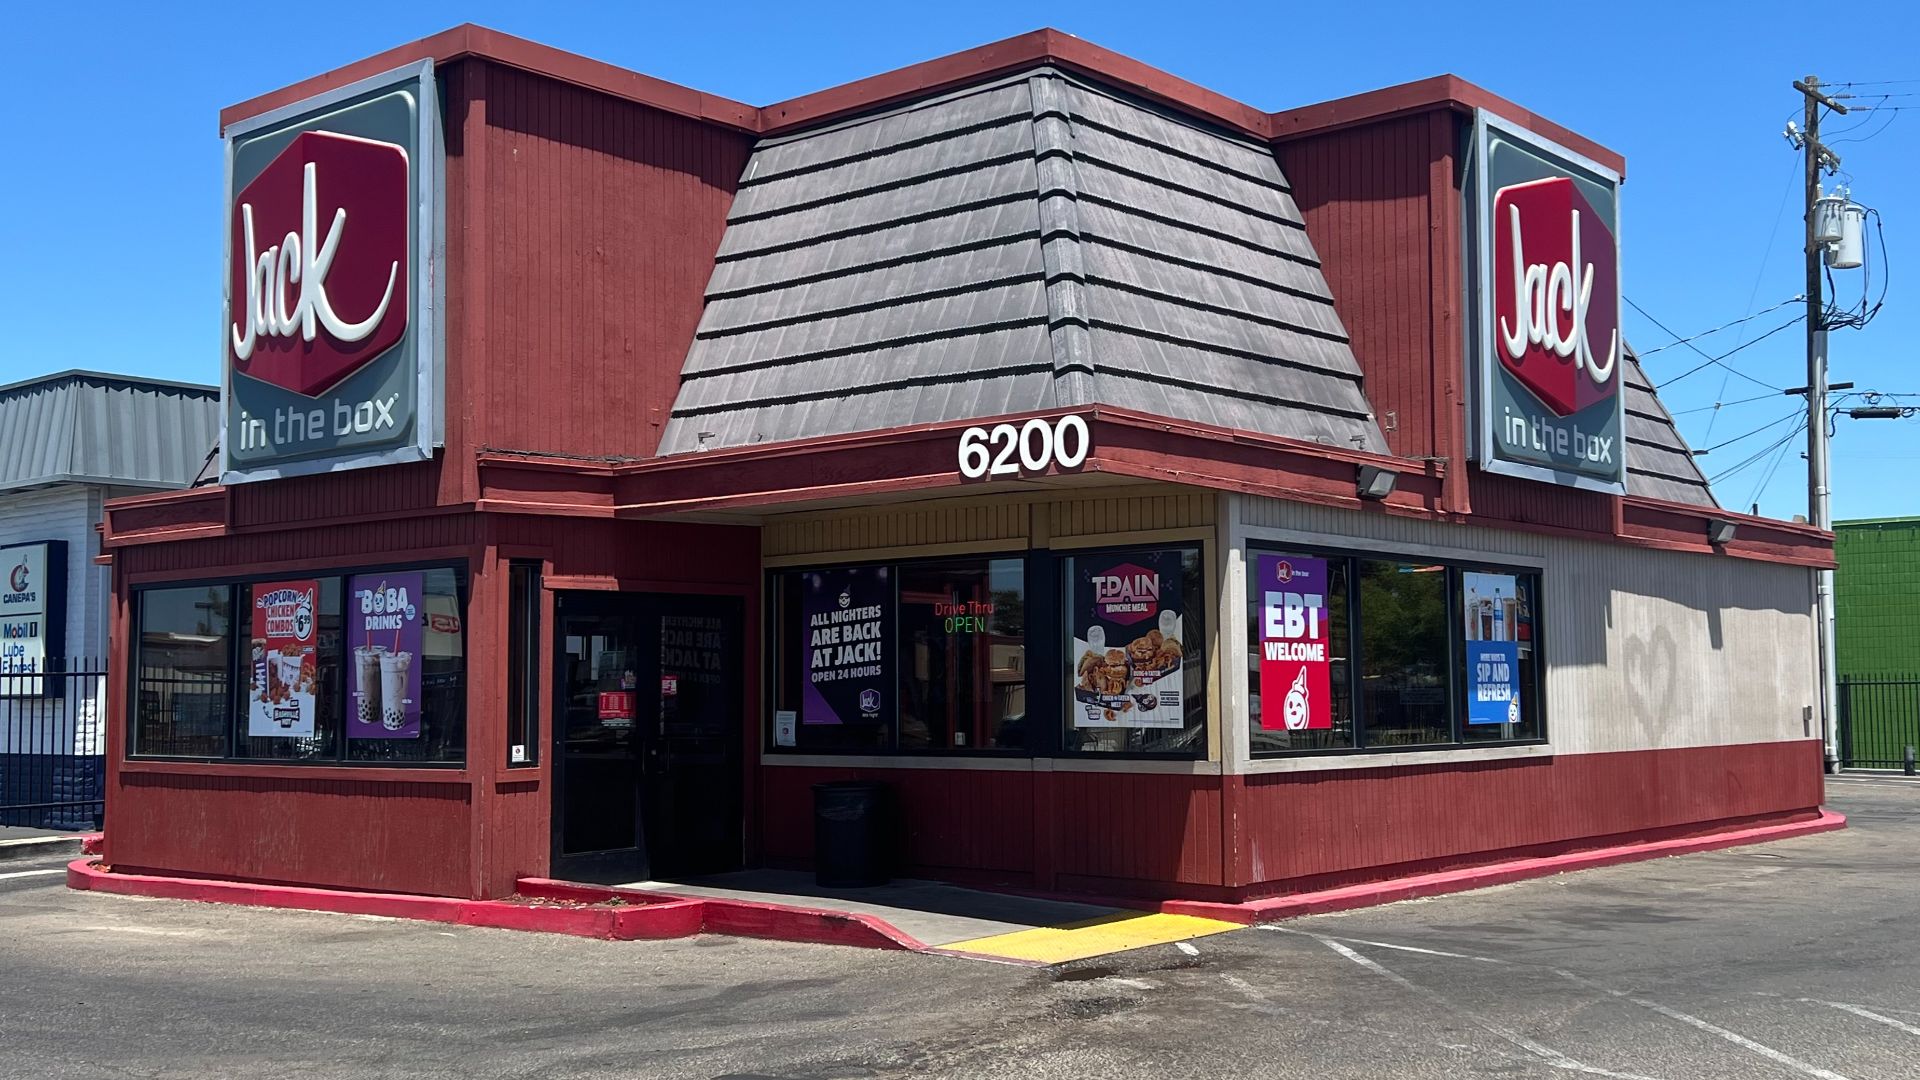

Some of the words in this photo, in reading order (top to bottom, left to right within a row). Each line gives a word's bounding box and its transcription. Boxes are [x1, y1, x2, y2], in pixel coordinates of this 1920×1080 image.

[233, 162, 398, 360] Jack
[1501, 204, 1616, 383] Jack
[241, 411, 266, 450] in
[275, 406, 325, 445] the
[333, 398, 395, 436] box
[1504, 406, 1526, 447] in
[1532, 414, 1568, 455] the
[1574, 424, 1612, 464] box
[958, 415, 1089, 478] 6200
[3, 592, 36, 604] CANEPA'S
[264, 590, 298, 607] POPCORN
[361, 587, 408, 614] BOBA
[267, 604, 295, 618] CHICKEN
[811, 613, 829, 627] ALL
[831, 605, 881, 624] NIGHTERS
[935, 602, 966, 616] Drive
[967, 601, 994, 615] Thru
[1106, 603, 1132, 613] MUNCHIE
[1132, 603, 1148, 612] MEAL
[1265, 591, 1322, 639] EBT
[3, 622, 28, 639] Mobil
[267, 619, 294, 634] COMBOS
[365, 615, 402, 631] DRINKS
[945, 616, 984, 634] OPEN
[811, 627, 840, 647] ARE
[843, 621, 881, 642] BACK
[3, 642, 25, 658] Lube
[811, 648, 833, 668] AT
[835, 641, 881, 666] JACK!
[1265, 642, 1325, 662] WELCOME
[811, 670, 836, 683] OPEN
[838, 669, 848, 680] 24
[850, 665, 881, 678] HOURS
[1477, 663, 1491, 682] SIP
[1492, 663, 1510, 682] AND
[1478, 684, 1511, 702] REFRESH
